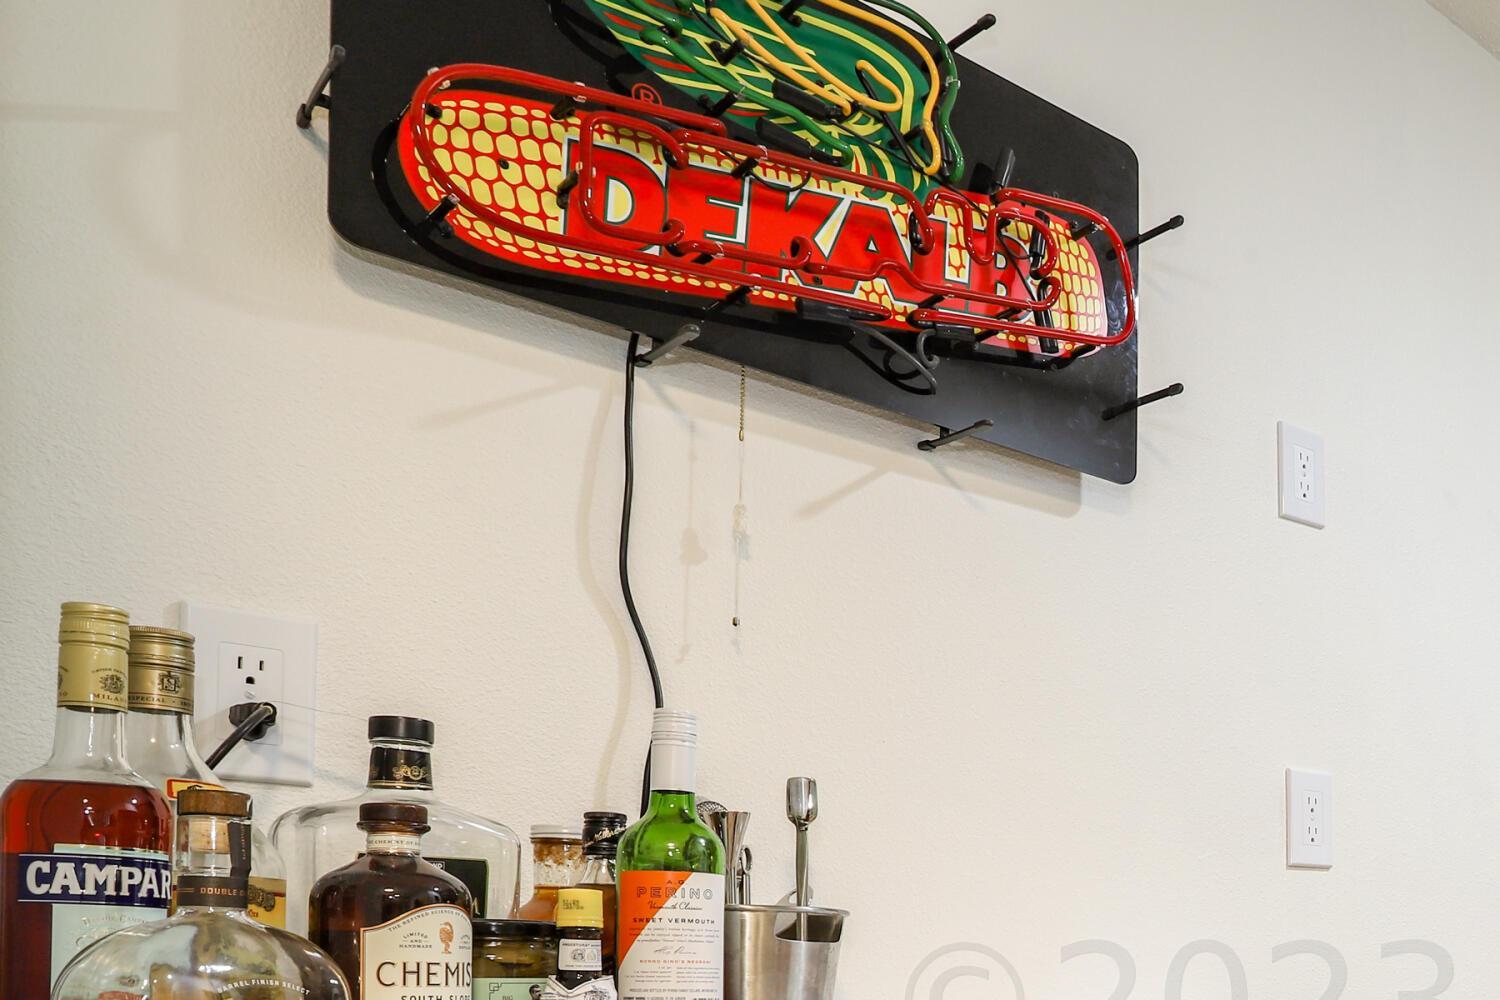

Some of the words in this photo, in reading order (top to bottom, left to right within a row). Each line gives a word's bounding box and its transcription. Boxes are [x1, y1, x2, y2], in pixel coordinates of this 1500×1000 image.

[200, 887, 237, 896] DOUBLE
[637, 886, 713, 900] PERINO
[403, 931, 428, 939] LIMITED
[217, 980, 250, 993] BARREL
[282, 981, 310, 996] SELECT
